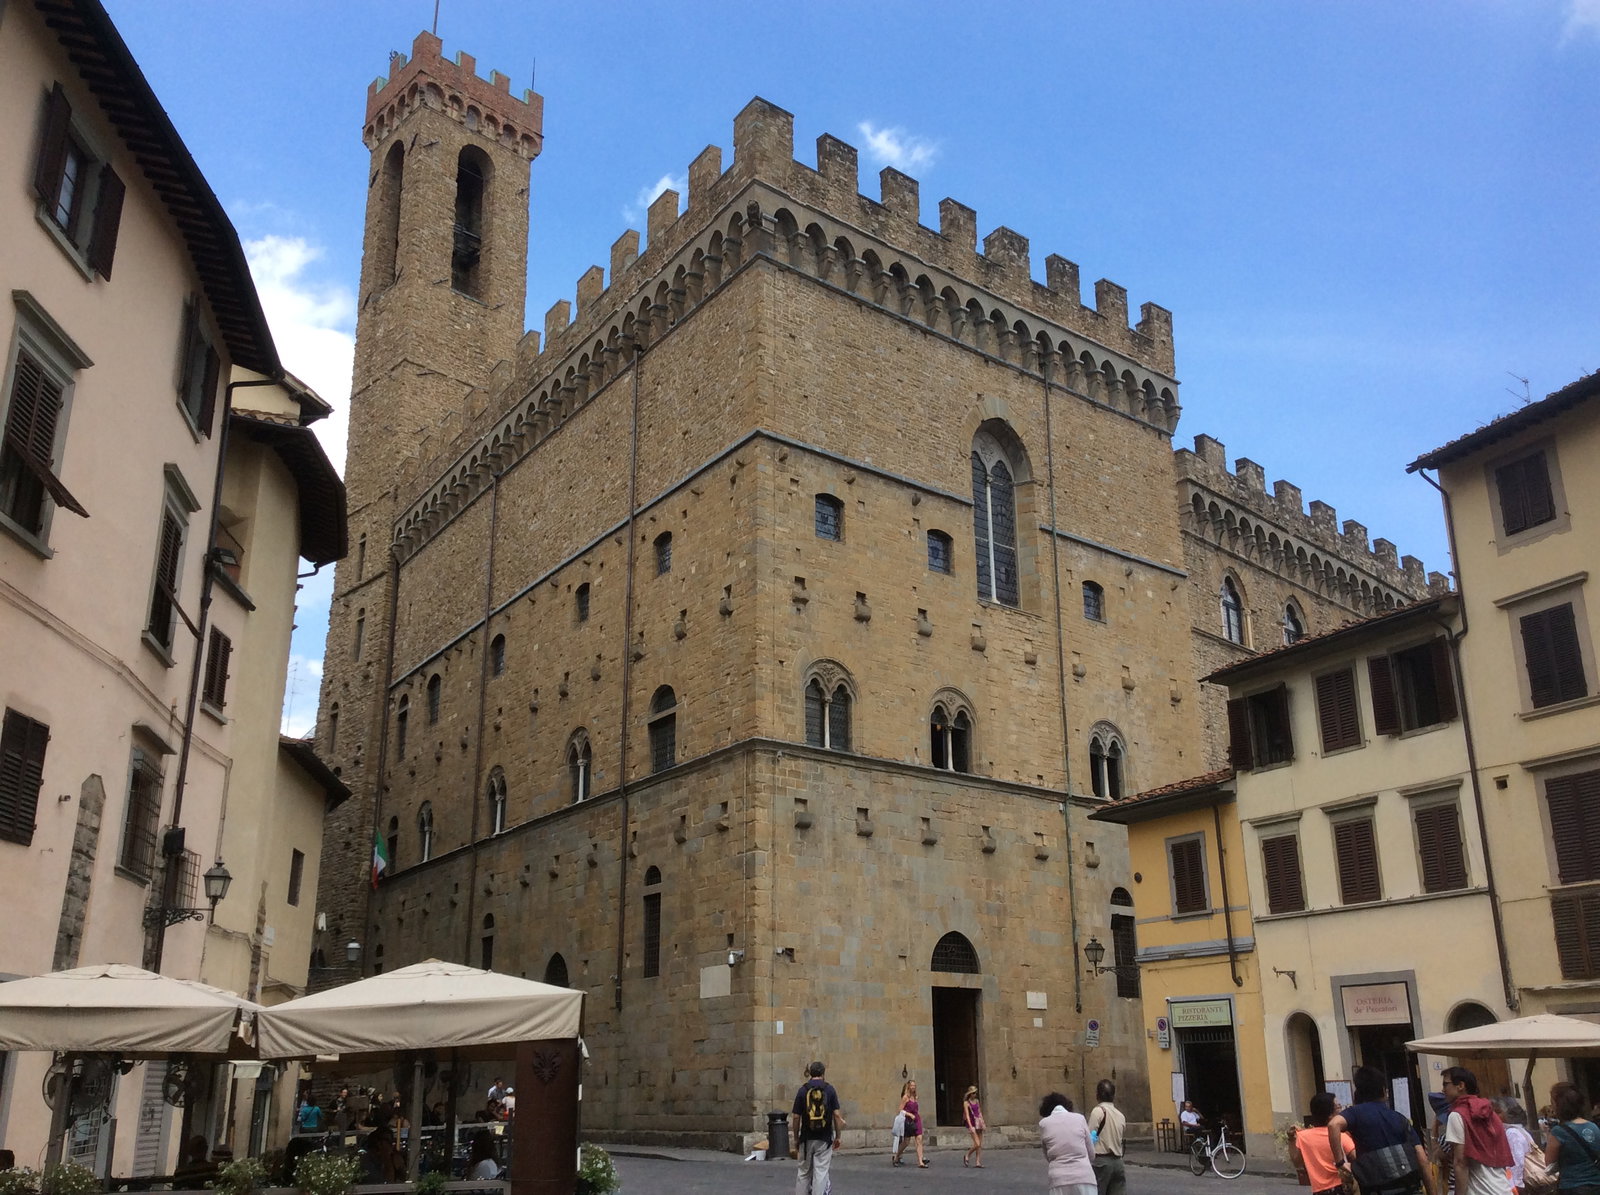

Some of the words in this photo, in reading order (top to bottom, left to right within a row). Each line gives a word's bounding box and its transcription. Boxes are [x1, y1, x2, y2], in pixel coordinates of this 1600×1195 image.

[1356, 997, 1393, 1005] OSTERIA
[1182, 1006, 1223, 1015] RISTORANTE
[1178, 1014, 1208, 1022] PIZZERIA
